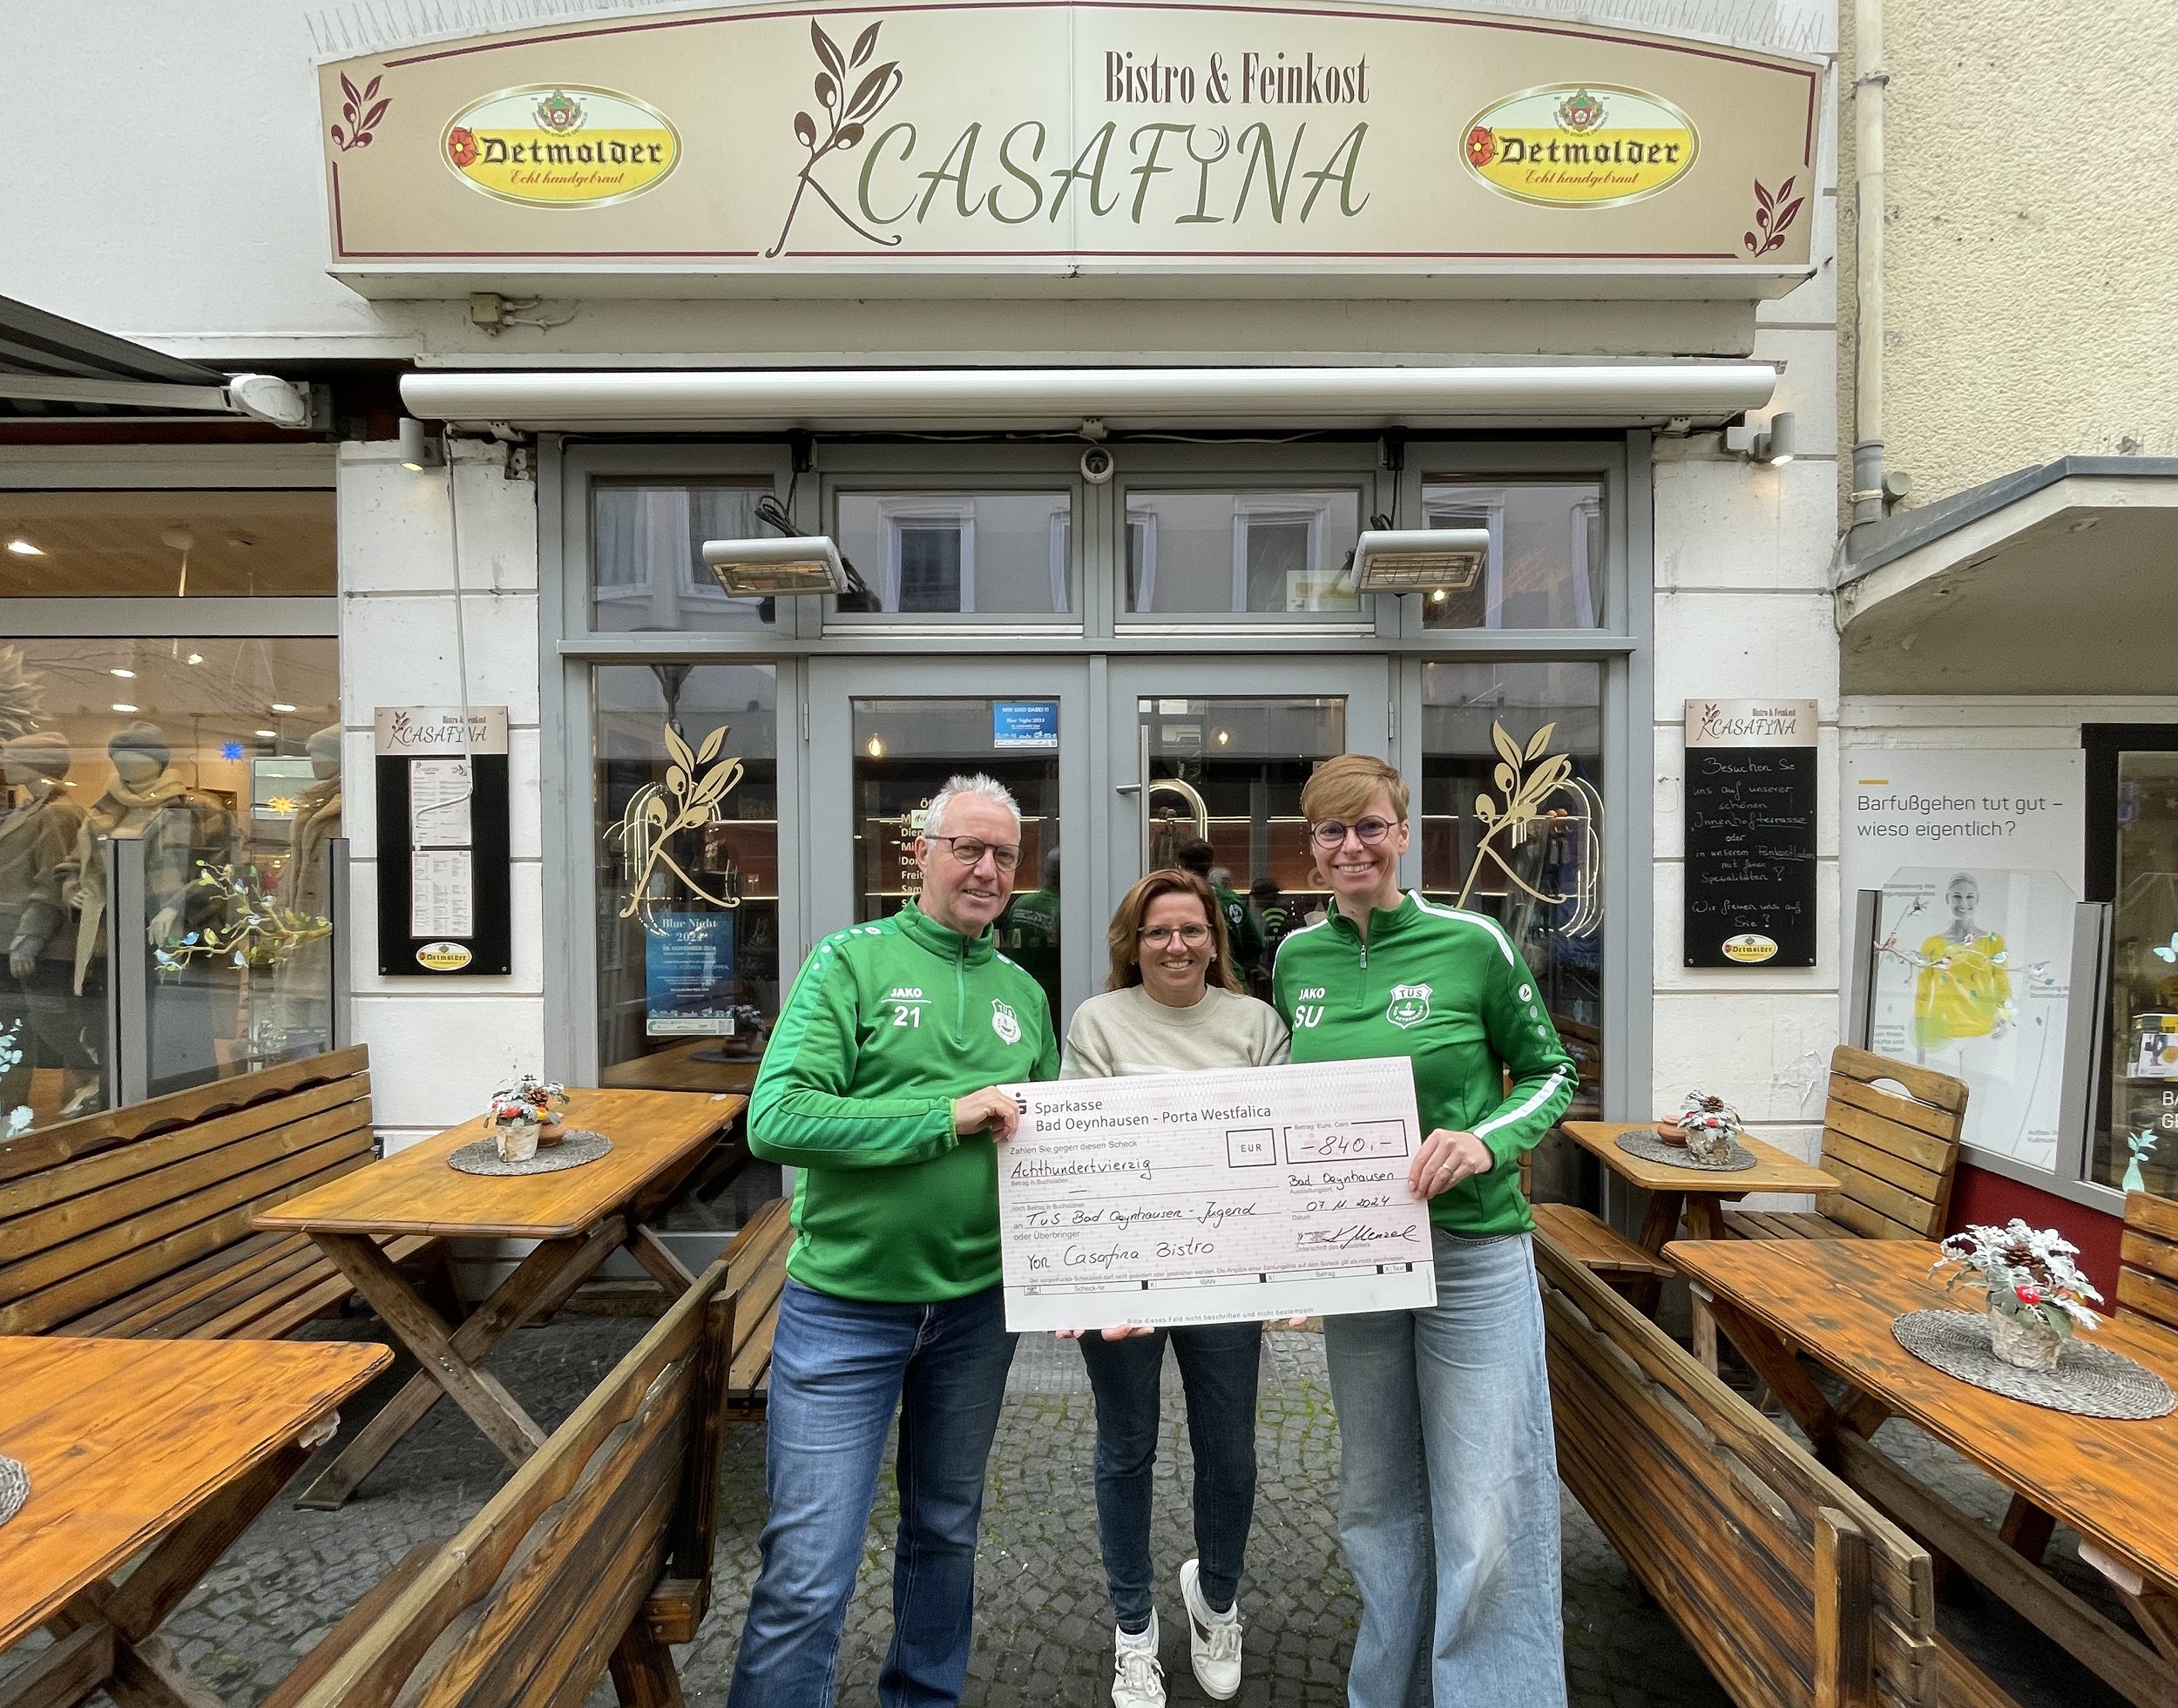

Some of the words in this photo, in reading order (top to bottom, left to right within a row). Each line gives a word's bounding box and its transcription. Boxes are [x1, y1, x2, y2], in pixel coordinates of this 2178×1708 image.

[1104, 51, 1196, 105] Bistro
[1206, 51, 1232, 105] &
[1241, 51, 1370, 105] Feinkost
[479, 136, 663, 165] Detmolder
[1498, 135, 1680, 165] Detmolder
[511, 170, 540, 184] Echt
[543, 171, 624, 186] handgebraut
[1525, 170, 1555, 184] Echt
[1556, 171, 1640, 188] handgebraut
[1701, 757, 1772, 774] Besuchen
[1721, 780, 1741, 800] auf
[1857, 795, 1975, 814] Barfußgehen
[1982, 797, 2009, 810] tut
[2015, 797, 2046, 814] gut
[1857, 822, 1909, 836] wieso
[662, 918, 686, 928] Blue
[689, 918, 717, 929] Night
[890, 988, 923, 998] JAKO
[1298, 987, 1326, 1001] JAKO
[1399, 989, 1424, 998] TUS
[893, 1005, 921, 1028] 21
[1295, 1005, 1325, 1029] SU
[1035, 1100, 1103, 1117] Sparkasse
[1036, 1118, 1060, 1132] Bad
[1065, 1114, 1149, 1132] Oeynhausen
[1162, 1111, 1197, 1124] Porta
[1201, 1105, 1271, 1120] Westfalica
[1010, 1146, 1037, 1155] Zahlen
[1053, 1144, 1078, 1155] gegen
[1079, 1141, 1106, 1151] diesen
[1108, 1139, 1137, 1149] Scheck
[1241, 1144, 1262, 1152] EUR
[1011, 1158, 1153, 1180] Achthundertvierzig
[1288, 1174, 1312, 1186] Bad
[1322, 1170, 1395, 1191] Oeynhausen
[1356, 1195, 1390, 1207] 2024
[1072, 1208, 1105, 1225] Bad
[1198, 1201, 1256, 1229] Jugend
[1013, 1232, 1032, 1241] oder
[1033, 1231, 1080, 1240] Überbringer
[1156, 1237, 1214, 1258] Bistro
